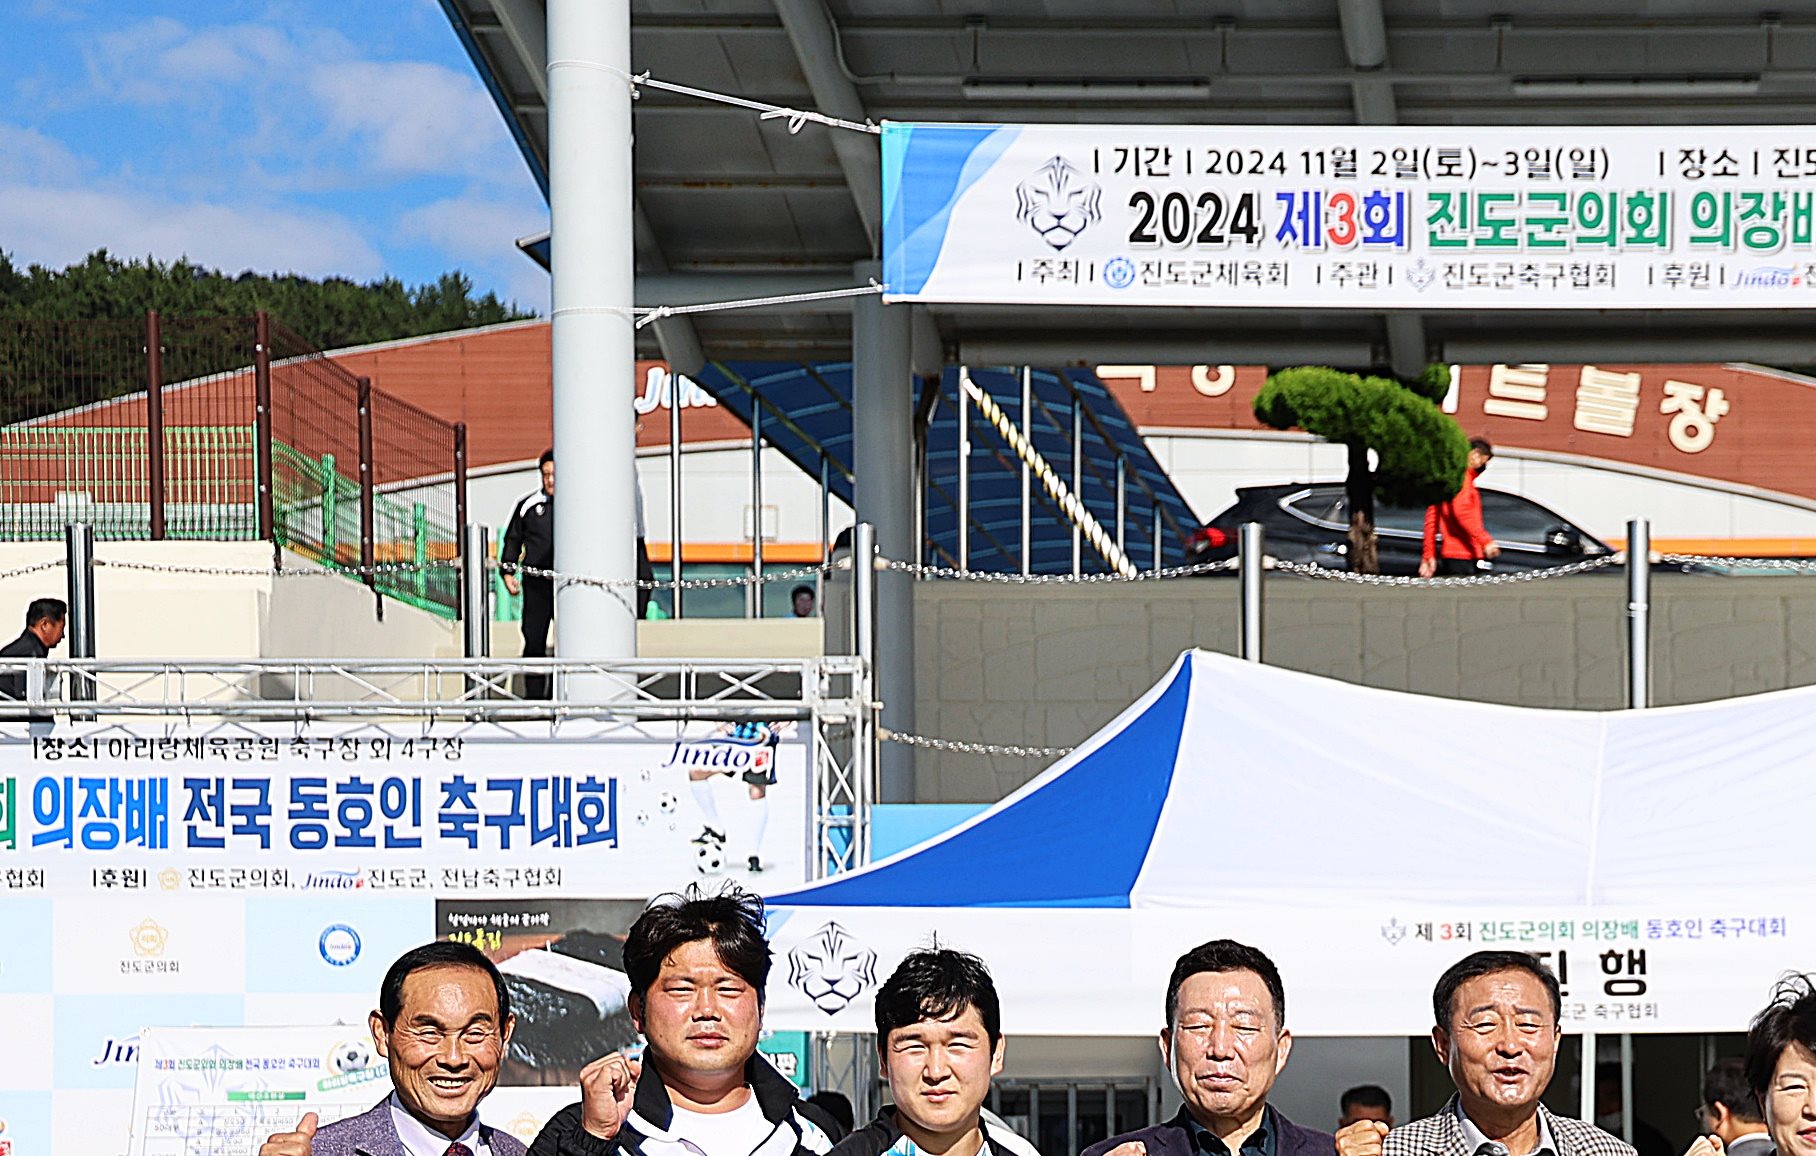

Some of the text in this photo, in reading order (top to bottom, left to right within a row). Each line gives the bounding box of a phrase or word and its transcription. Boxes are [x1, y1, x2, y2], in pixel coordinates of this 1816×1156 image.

[1113, 147, 1173, 178] 기간
[1205, 151, 1288, 176] 2024
[1299, 147, 1359, 180] 11월
[1678, 148, 1742, 178] 장소
[1127, 190, 1260, 246] 2024
[1274, 188, 1405, 248] 제3회
[1426, 188, 1667, 248] 진도군의회
[1031, 259, 1288, 287] 주최 진도군체육회
[1330, 260, 1617, 290] 주관 진도군축구협회
[1662, 261, 1712, 290] 후원
[108, 738, 279, 761] 아리랑체육공원
[288, 738, 362, 760] 축구장
[368, 739, 391, 760] 외
[401, 738, 465, 760] 4구장
[31, 775, 169, 850] 의장배
[183, 776, 273, 850] 전국
[287, 775, 423, 850] 동호인
[438, 774, 619, 850] 축구대회
[0, 868, 44, 889] 협회
[440, 867, 562, 888] 전남축구협회
[1414, 916, 1787, 942] 제 3회 진도군의회 의장배 동호인 축구대회
[1598, 948, 1648, 997] 행
